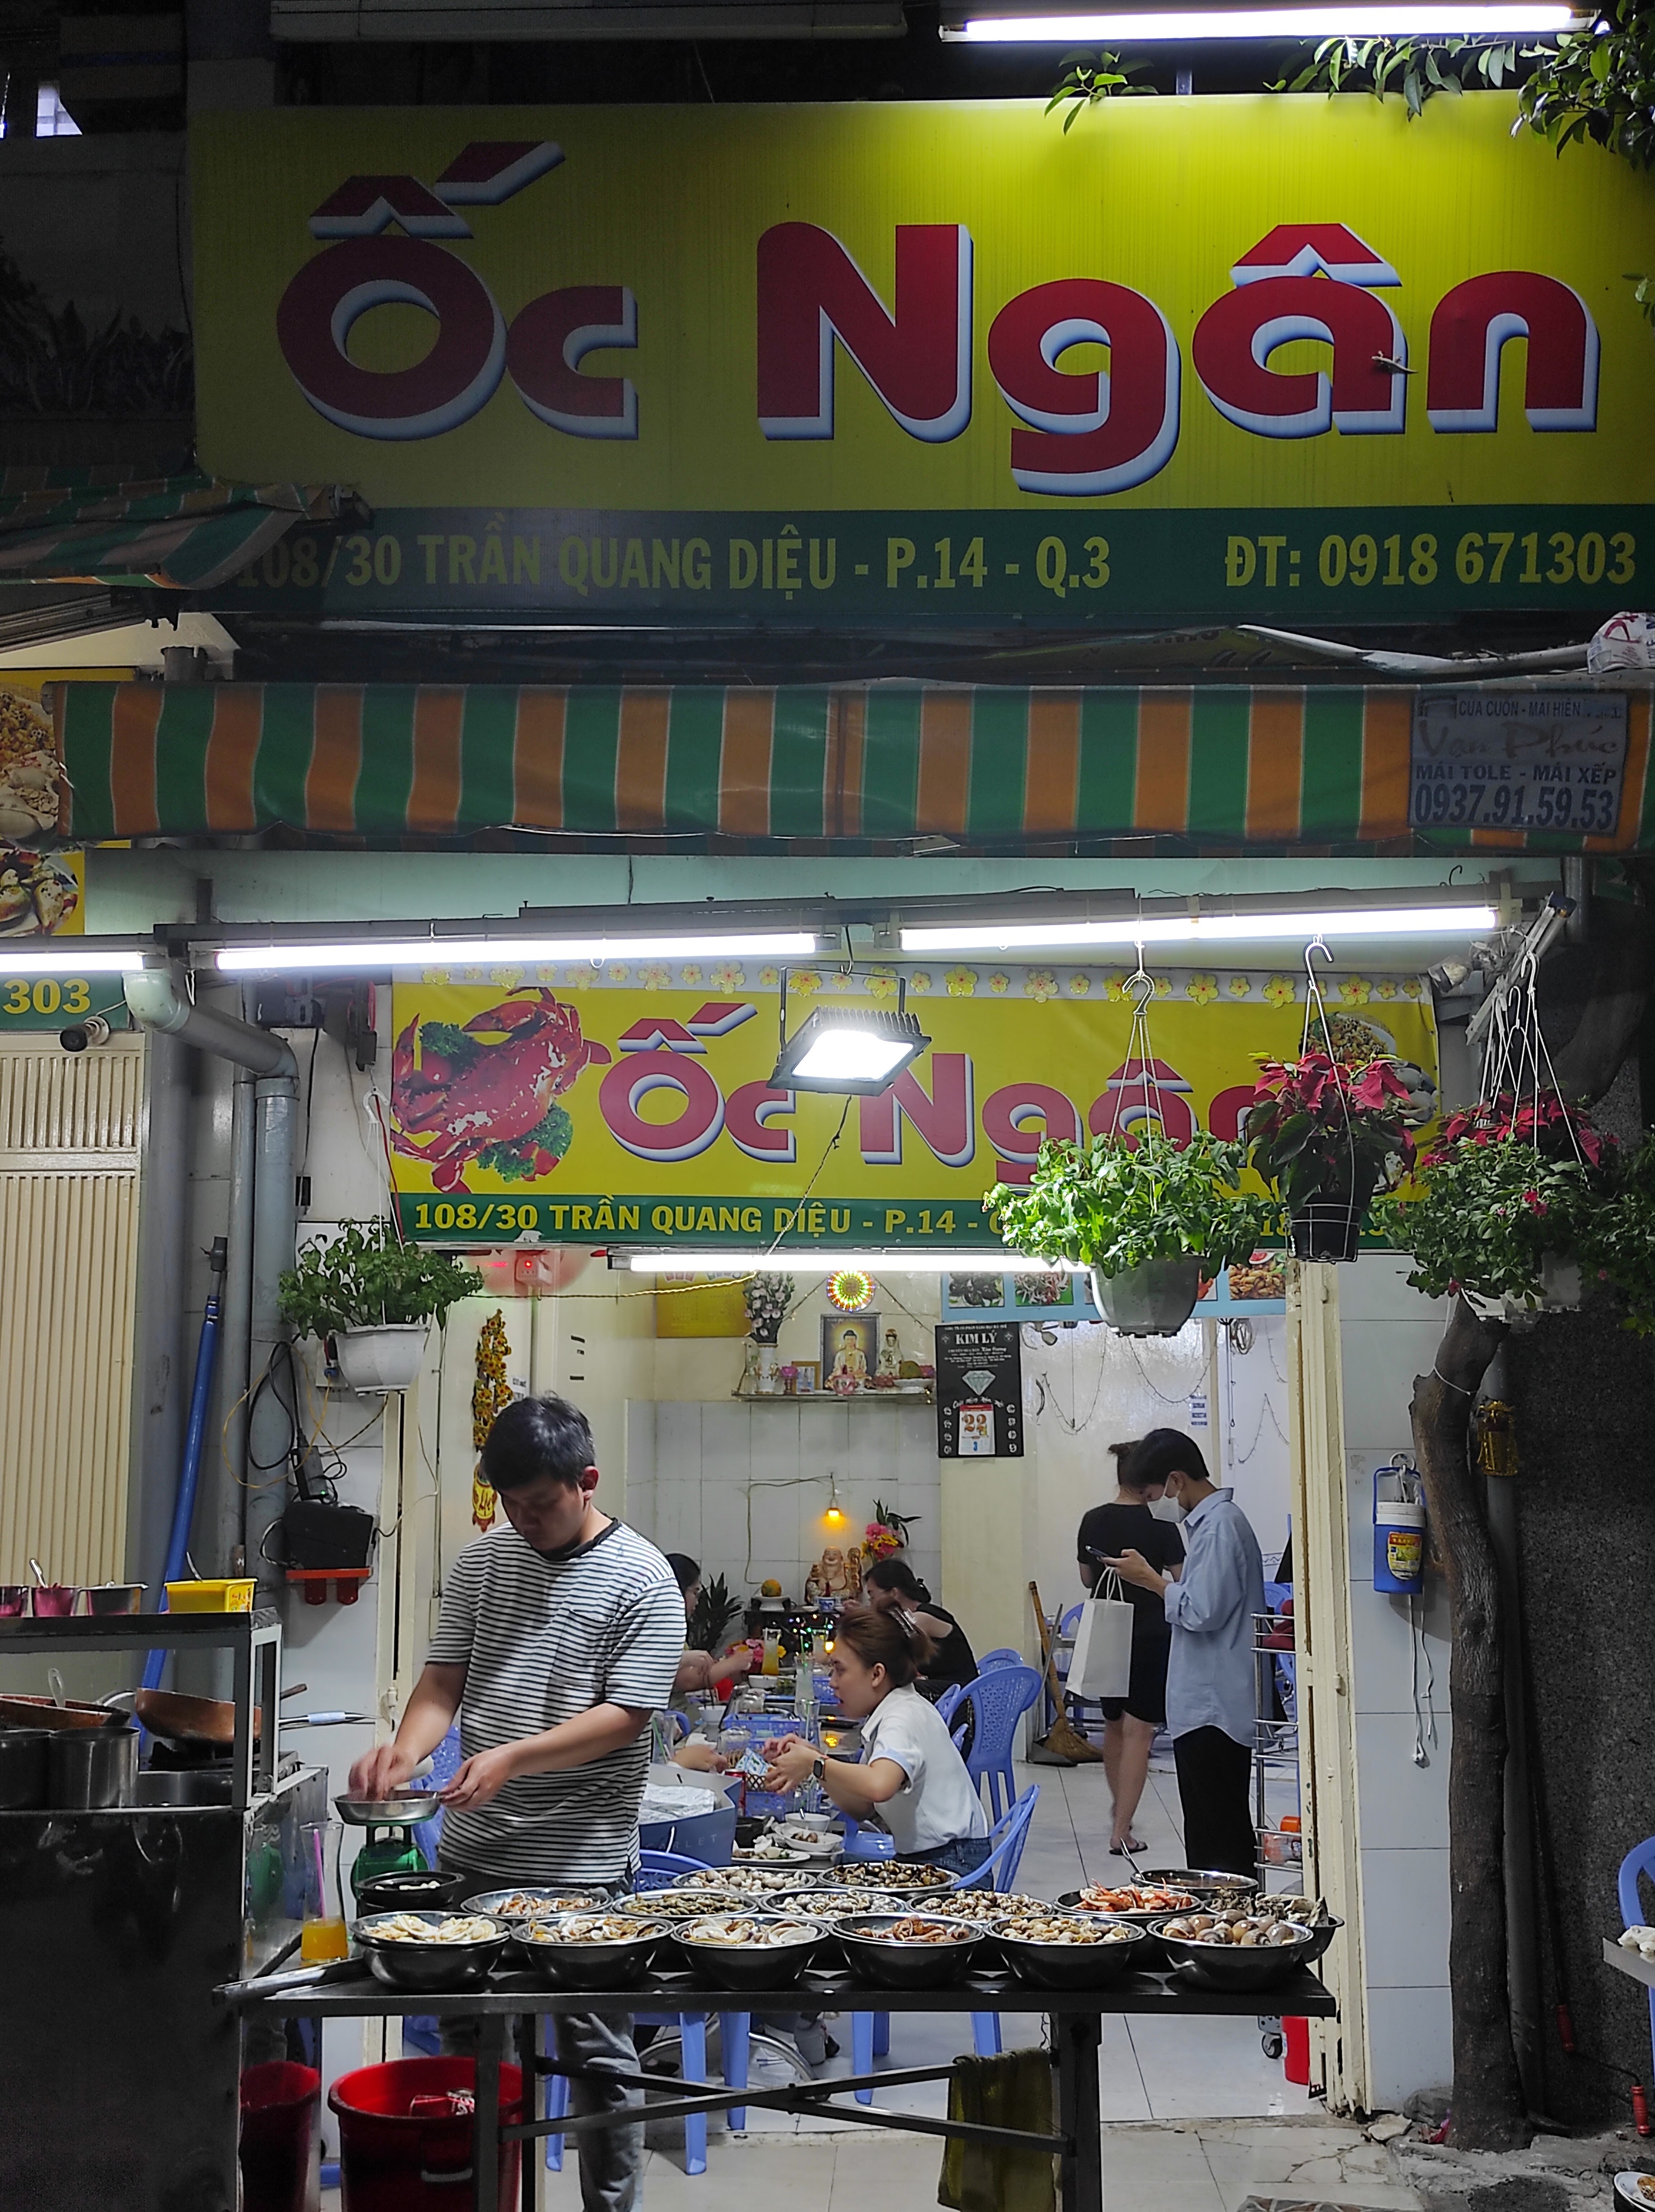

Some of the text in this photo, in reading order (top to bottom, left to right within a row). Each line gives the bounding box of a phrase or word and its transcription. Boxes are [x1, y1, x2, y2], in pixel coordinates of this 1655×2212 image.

[276, 141, 1600, 496] Ốc Ngân
[417, 512, 541, 586] TRẦN
[558, 535, 711, 597] QUANG
[728, 524, 836, 600] DIỆU
[886, 537, 988, 589] P.14
[1036, 536, 1111, 598] Q.3
[1225, 535, 1300, 587] ĐT:
[1318, 533, 1439, 587] 0918
[1455, 531, 1636, 584] 671303
[1416, 761, 1453, 780] MÁI
[1460, 765, 1512, 780] TOLE
[1533, 762, 1571, 782] MÁI
[1577, 762, 1616, 785] XẾP
[1415, 783, 1614, 830] 0937.91.59.53
[2, 978, 91, 1014] 303
[598, 1002, 797, 1163] Ốc
[415, 1203, 538, 1231] 108/30
[549, 1194, 641, 1231] TRẦN
[651, 1205, 762, 1234] QUANG
[774, 1201, 851, 1239] DIỆU
[885, 1209, 956, 1234] P.14
[955, 1329, 997, 1345] KIM LÝ
